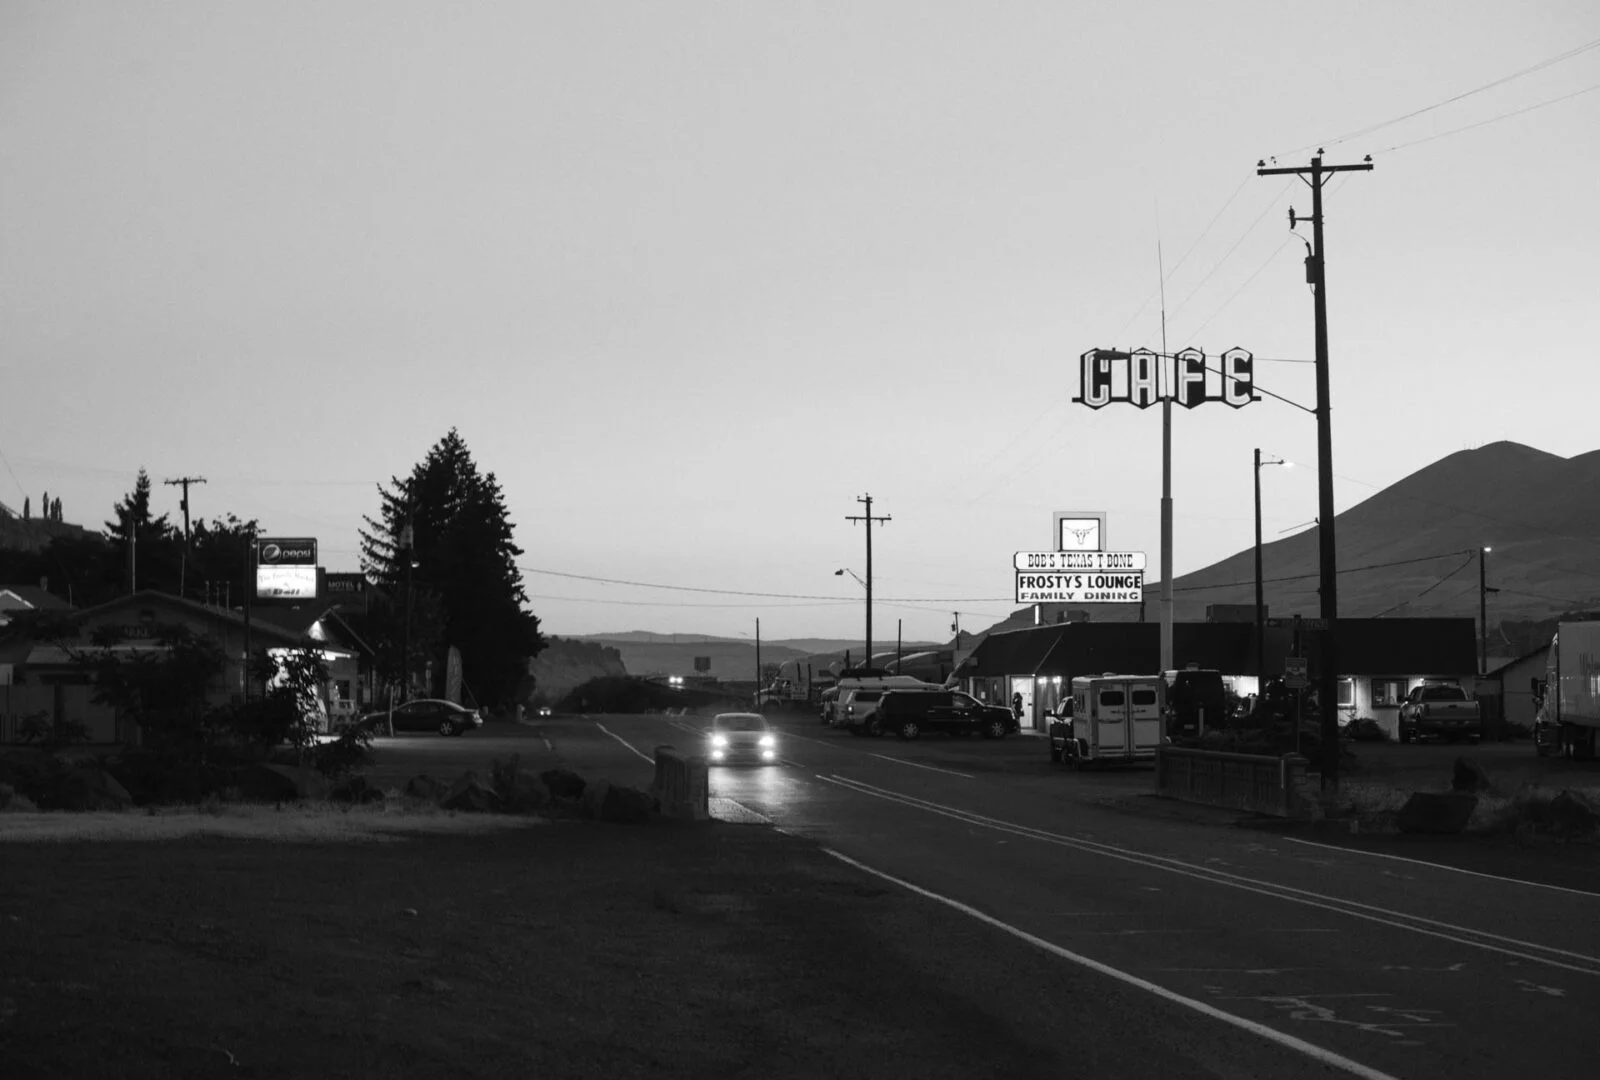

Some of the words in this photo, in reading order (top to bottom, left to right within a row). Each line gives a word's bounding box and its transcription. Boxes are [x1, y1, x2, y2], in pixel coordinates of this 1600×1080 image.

[1081, 347, 1253, 410] CAFE
[1028, 554, 1055, 568] BOB'S
[1060, 554, 1093, 568] TEXAS
[327, 580, 354, 588] MOTEL
[1019, 575, 1082, 589] FROSTY'S
[1087, 575, 1141, 589] LOUNGE
[1021, 592, 1075, 600] FAMILY
[1084, 592, 1139, 600] DINING
